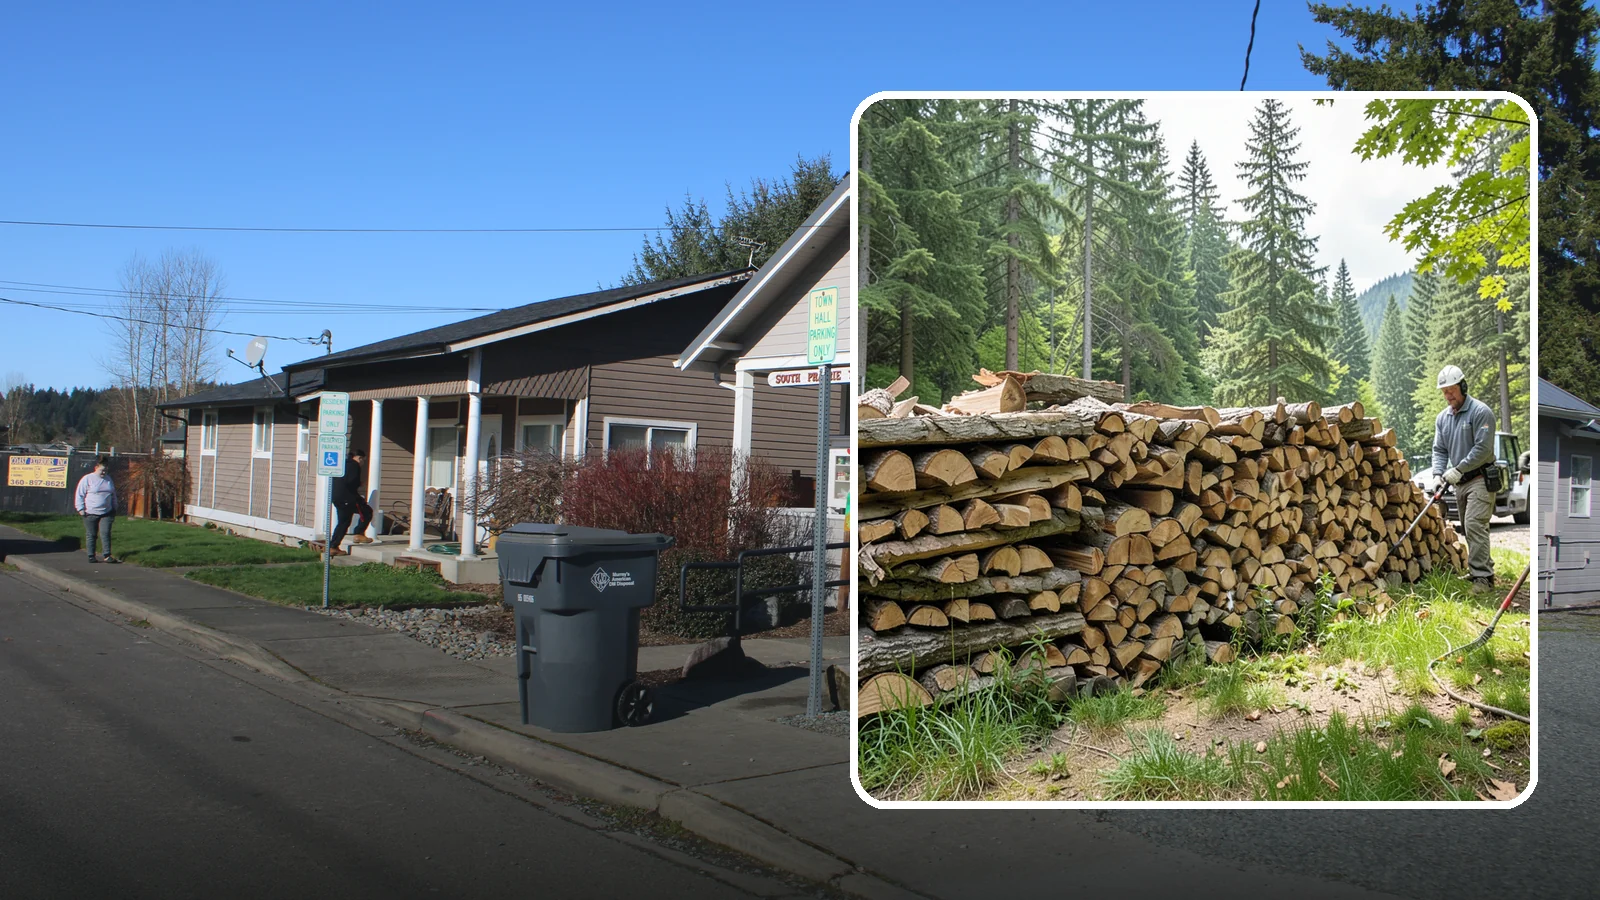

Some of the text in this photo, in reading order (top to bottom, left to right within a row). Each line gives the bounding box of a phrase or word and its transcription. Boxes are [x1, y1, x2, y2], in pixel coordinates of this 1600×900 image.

[815, 294, 833, 308] TOWN
[814, 311, 831, 324] HALL
[809, 326, 836, 341] PARKING
[813, 344, 831, 357] ONLY
[775, 373, 801, 384] SOUTH
[808, 370, 842, 382] PRRIE
[325, 420, 340, 428] ONLY
